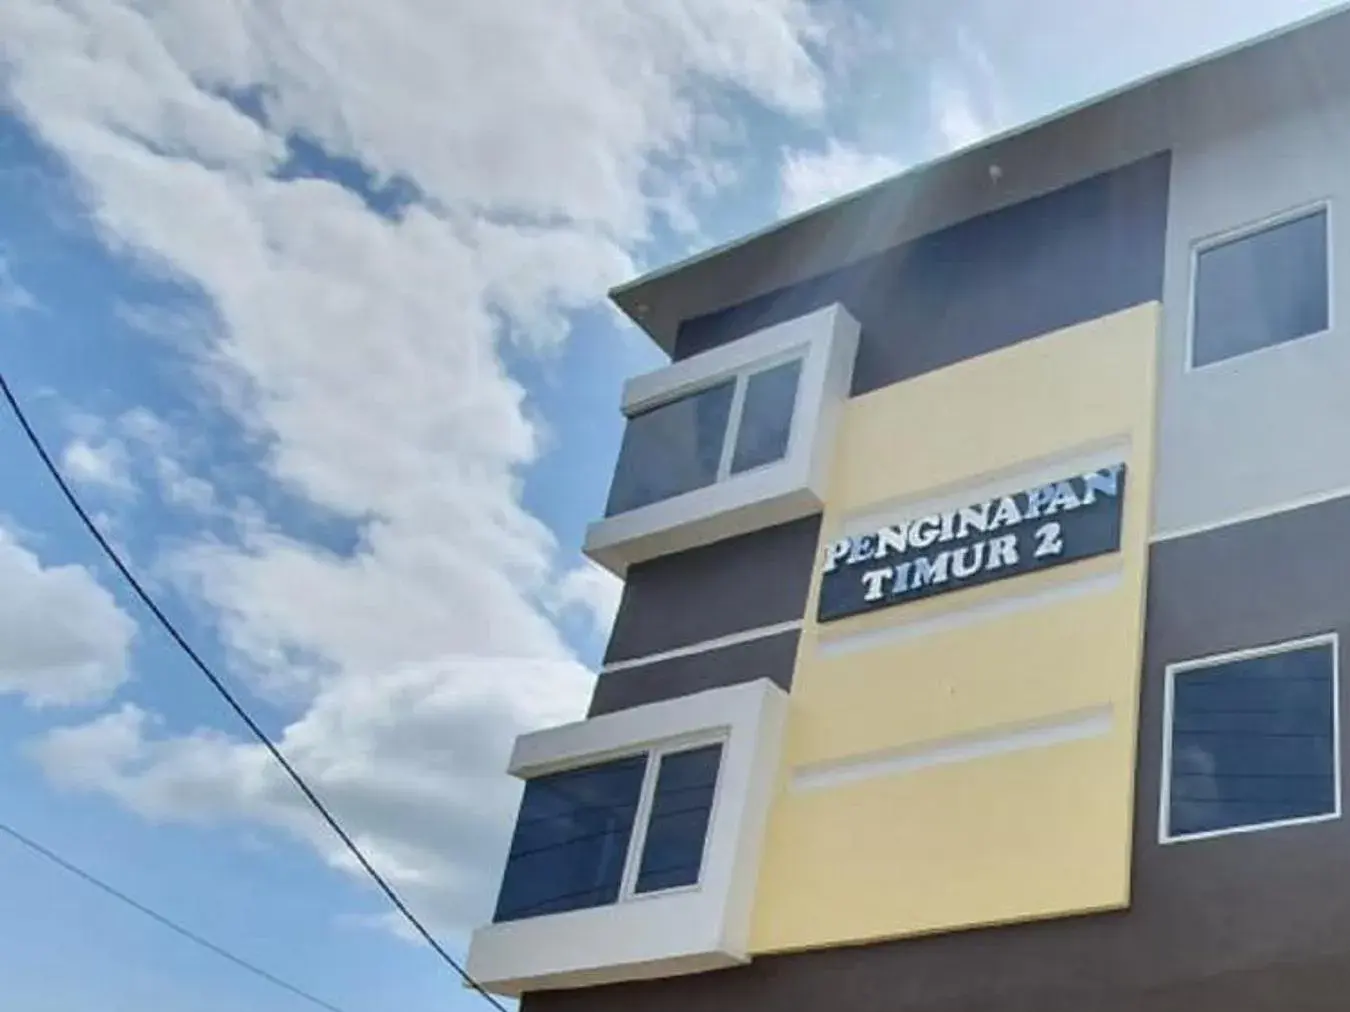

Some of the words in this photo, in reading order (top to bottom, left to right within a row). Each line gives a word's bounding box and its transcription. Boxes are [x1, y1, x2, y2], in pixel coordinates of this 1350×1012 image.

[823, 464, 1125, 572] PENGINAPAN
[861, 535, 1019, 601] TIMUR
[1035, 523, 1063, 557] 2
